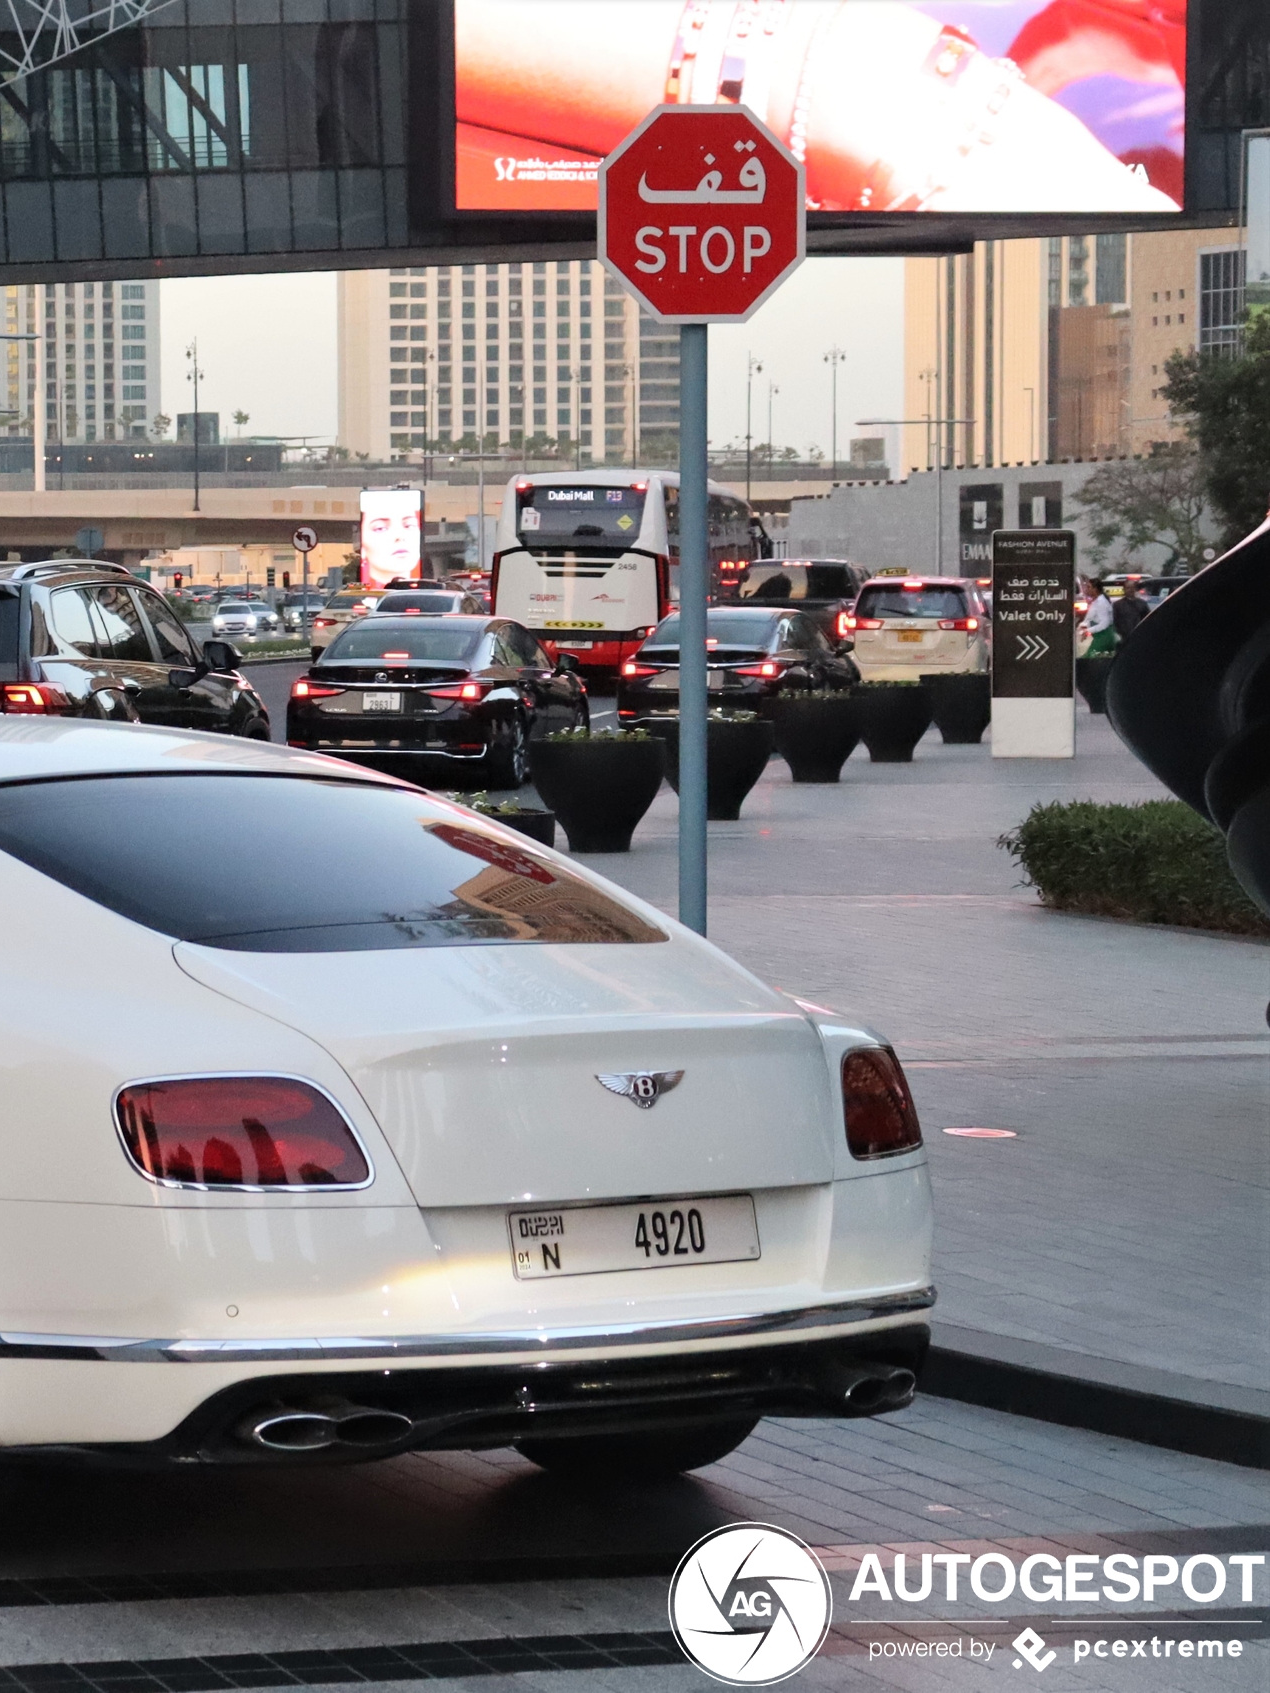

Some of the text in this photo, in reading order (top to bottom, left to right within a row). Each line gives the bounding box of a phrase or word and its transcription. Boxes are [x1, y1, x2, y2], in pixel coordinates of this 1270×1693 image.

[638, 139, 767, 204] قف
[634, 225, 772, 274] STOP
[548, 490, 622, 501] Dubai Mall F13
[998, 540, 1068, 548] FASHION AVENUE
[962, 543, 992, 560] EMAA
[618, 563, 637, 571] 2458
[1007, 575, 1060, 587] خدمة صف
[1000, 589, 1068, 604] السيارات فقط
[999, 610, 1066, 623] Valet Only
[635, 1208, 706, 1258] 4920
[518, 1251, 530, 1263] 01
[541, 1242, 561, 1270] N
